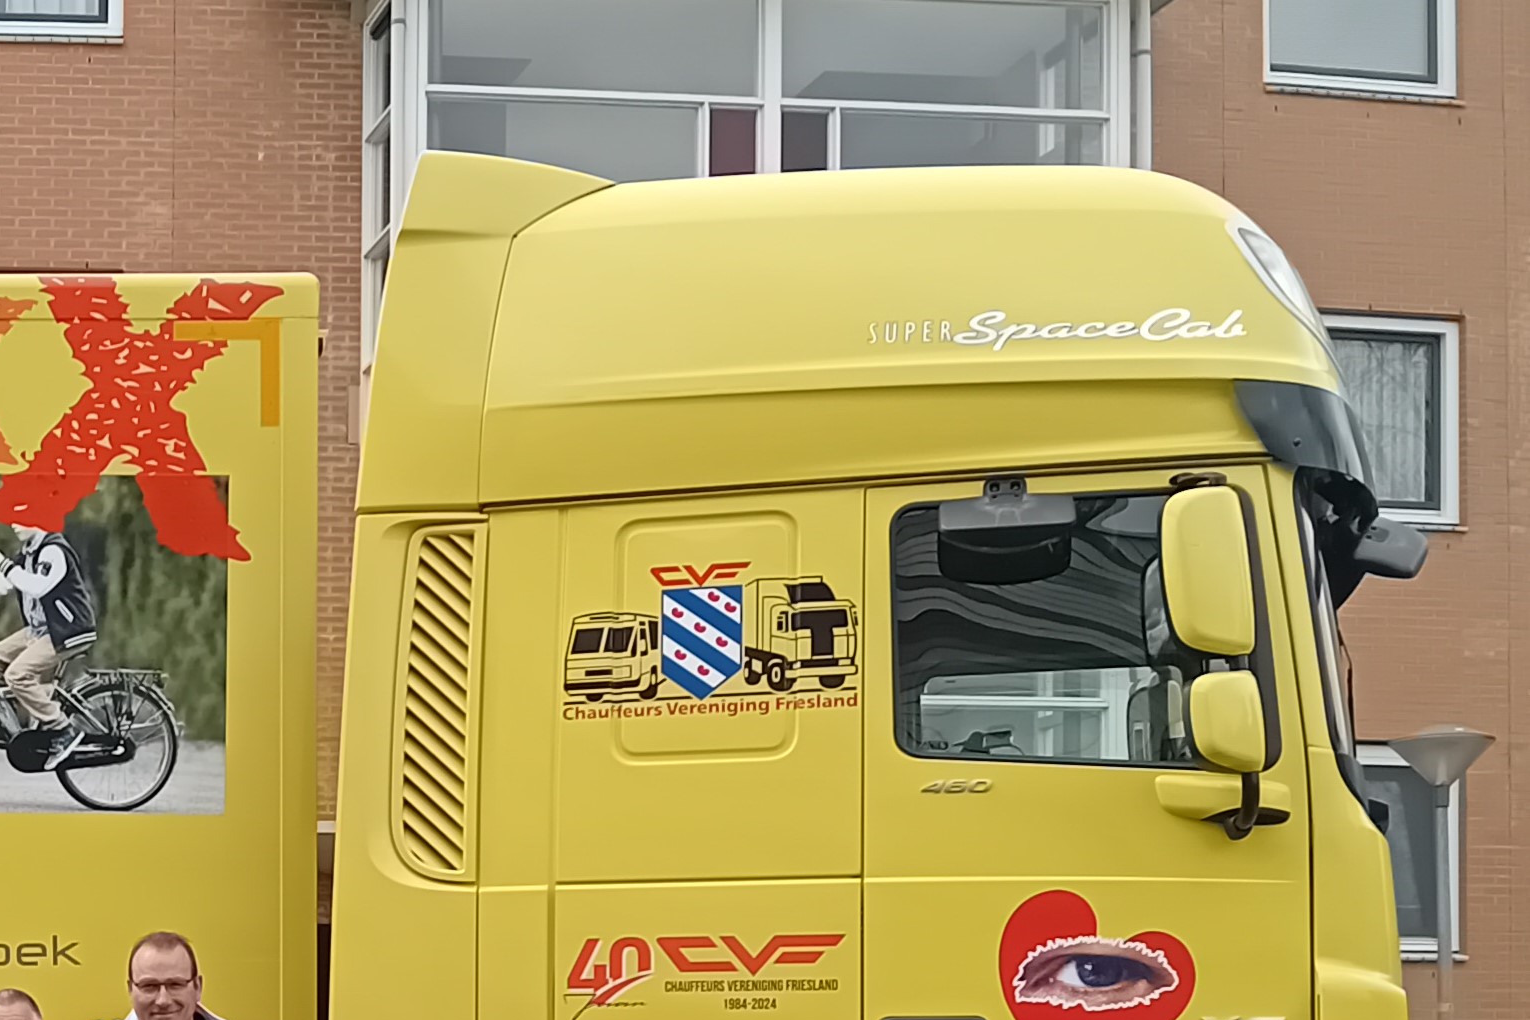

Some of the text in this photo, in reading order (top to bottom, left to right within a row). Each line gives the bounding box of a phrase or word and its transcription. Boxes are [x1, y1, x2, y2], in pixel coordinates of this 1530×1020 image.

[868, 320, 952, 344] SUPER
[649, 560, 752, 587] CVF
[562, 692, 859, 720] Chauffeurs Vereniging Friesland
[920, 779, 993, 794] 460
[566, 934, 846, 998] 40 CVF
[664, 979, 839, 993] CHAUFFEURS VERENIGING FRIESLAND
[723, 997, 777, 1010] 1984-2024
